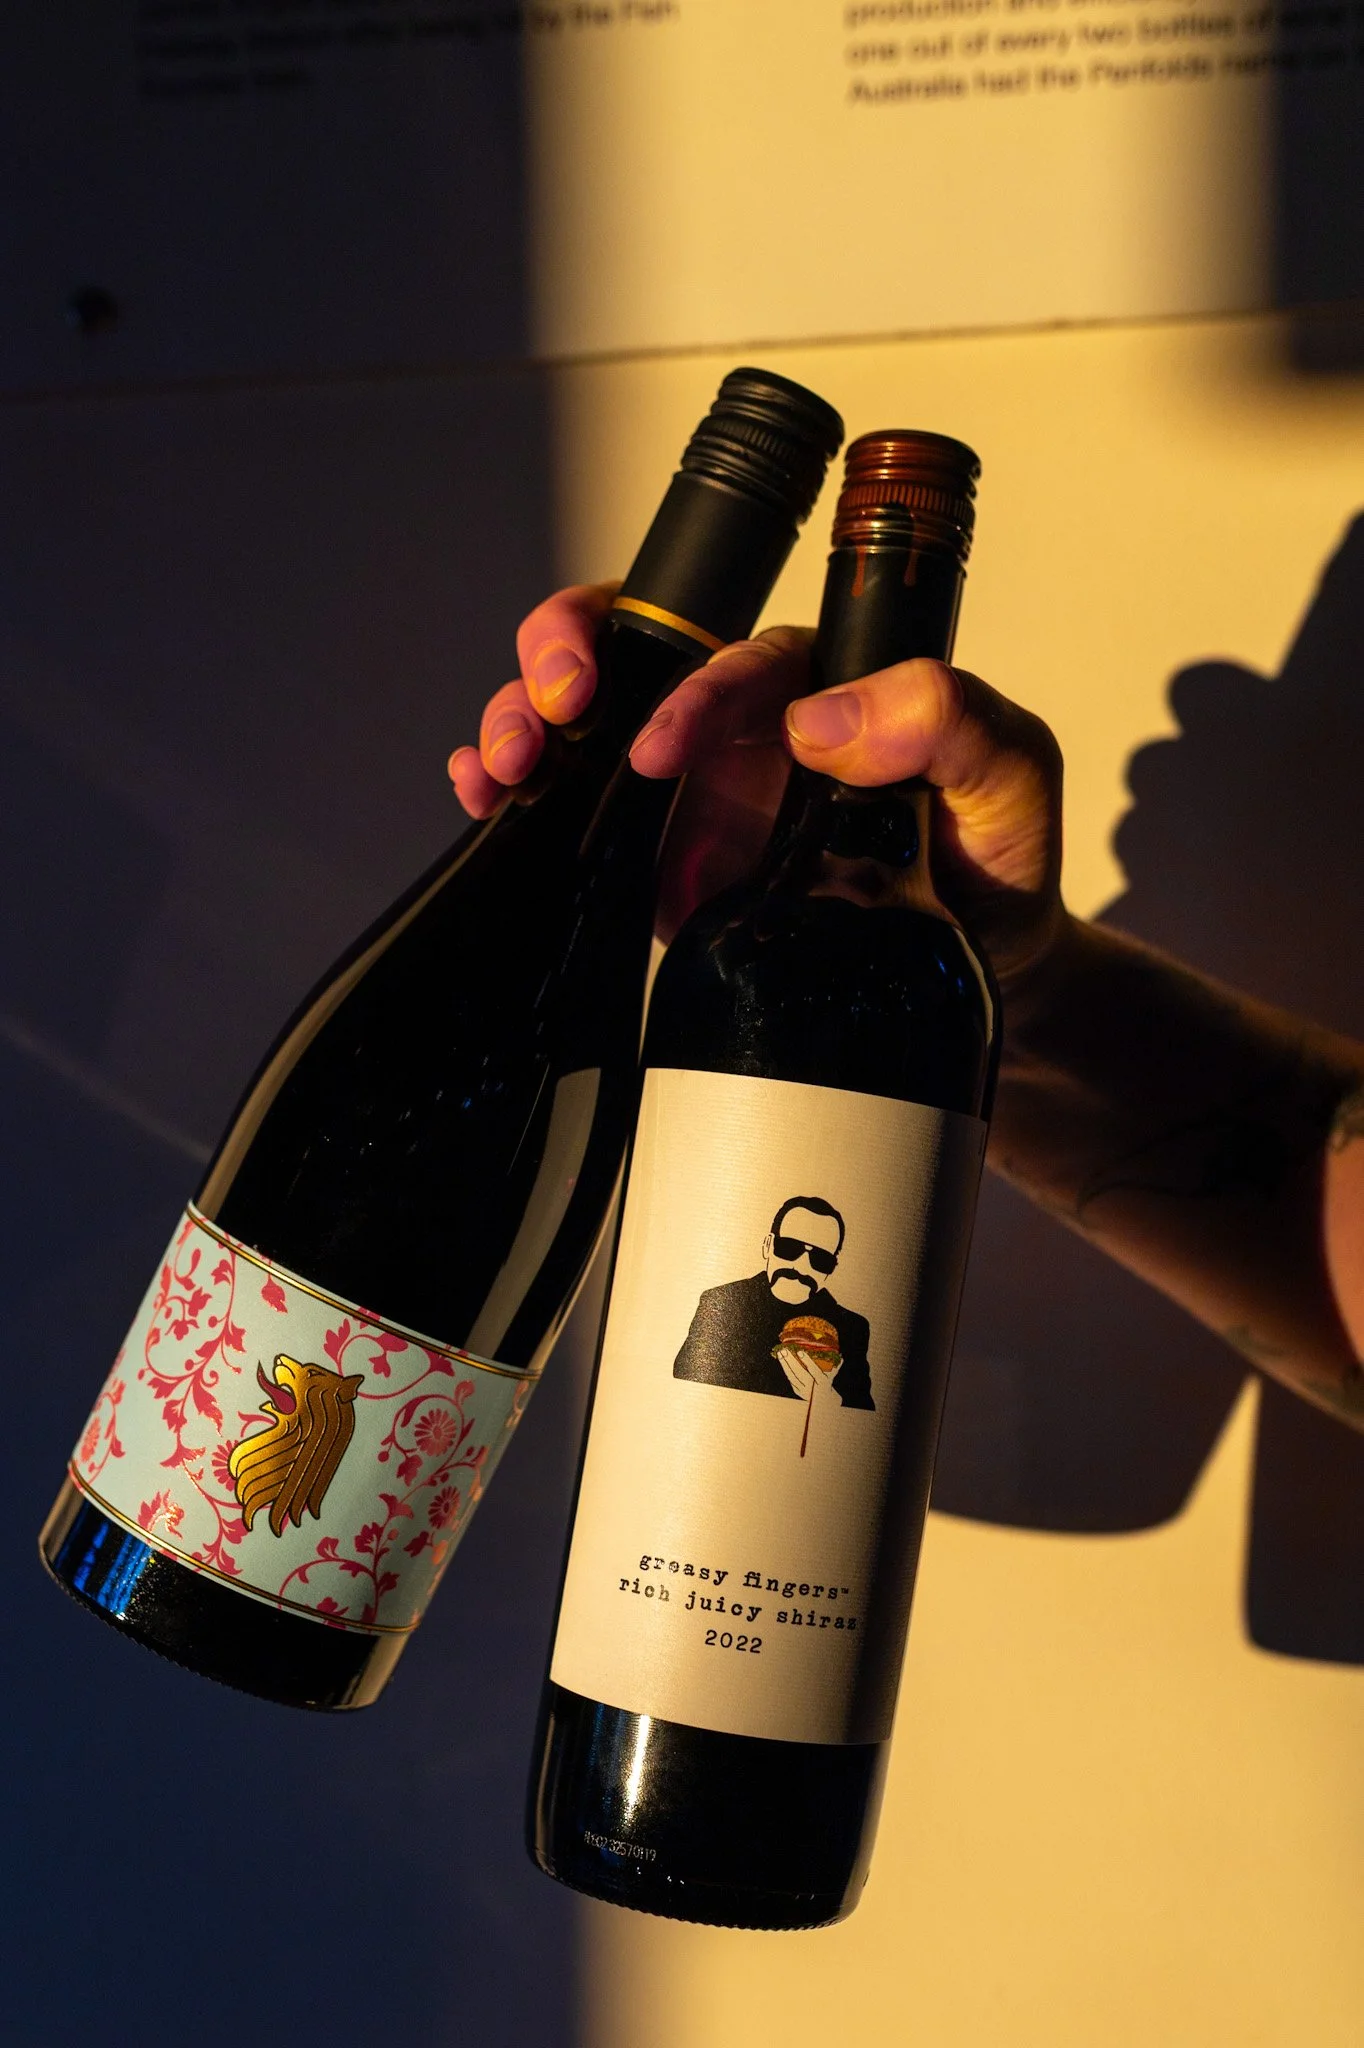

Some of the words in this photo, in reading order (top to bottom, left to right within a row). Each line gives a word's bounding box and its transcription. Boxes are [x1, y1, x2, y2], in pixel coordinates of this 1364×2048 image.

[849, 44, 898, 63] one
[908, 38, 952, 60] out
[962, 32, 990, 56] of
[998, 32, 1071, 55] every
[1079, 24, 1130, 45] two
[850, 77, 967, 101] Australia
[975, 70, 1029, 92] had
[1036, 65, 1081, 88] the
[639, 1554, 728, 1585] greasy
[619, 1577, 670, 1602] rich
[685, 1591, 762, 1622] juicy
[776, 1608, 857, 1631] shiraz
[705, 1629, 762, 1654] 2022
